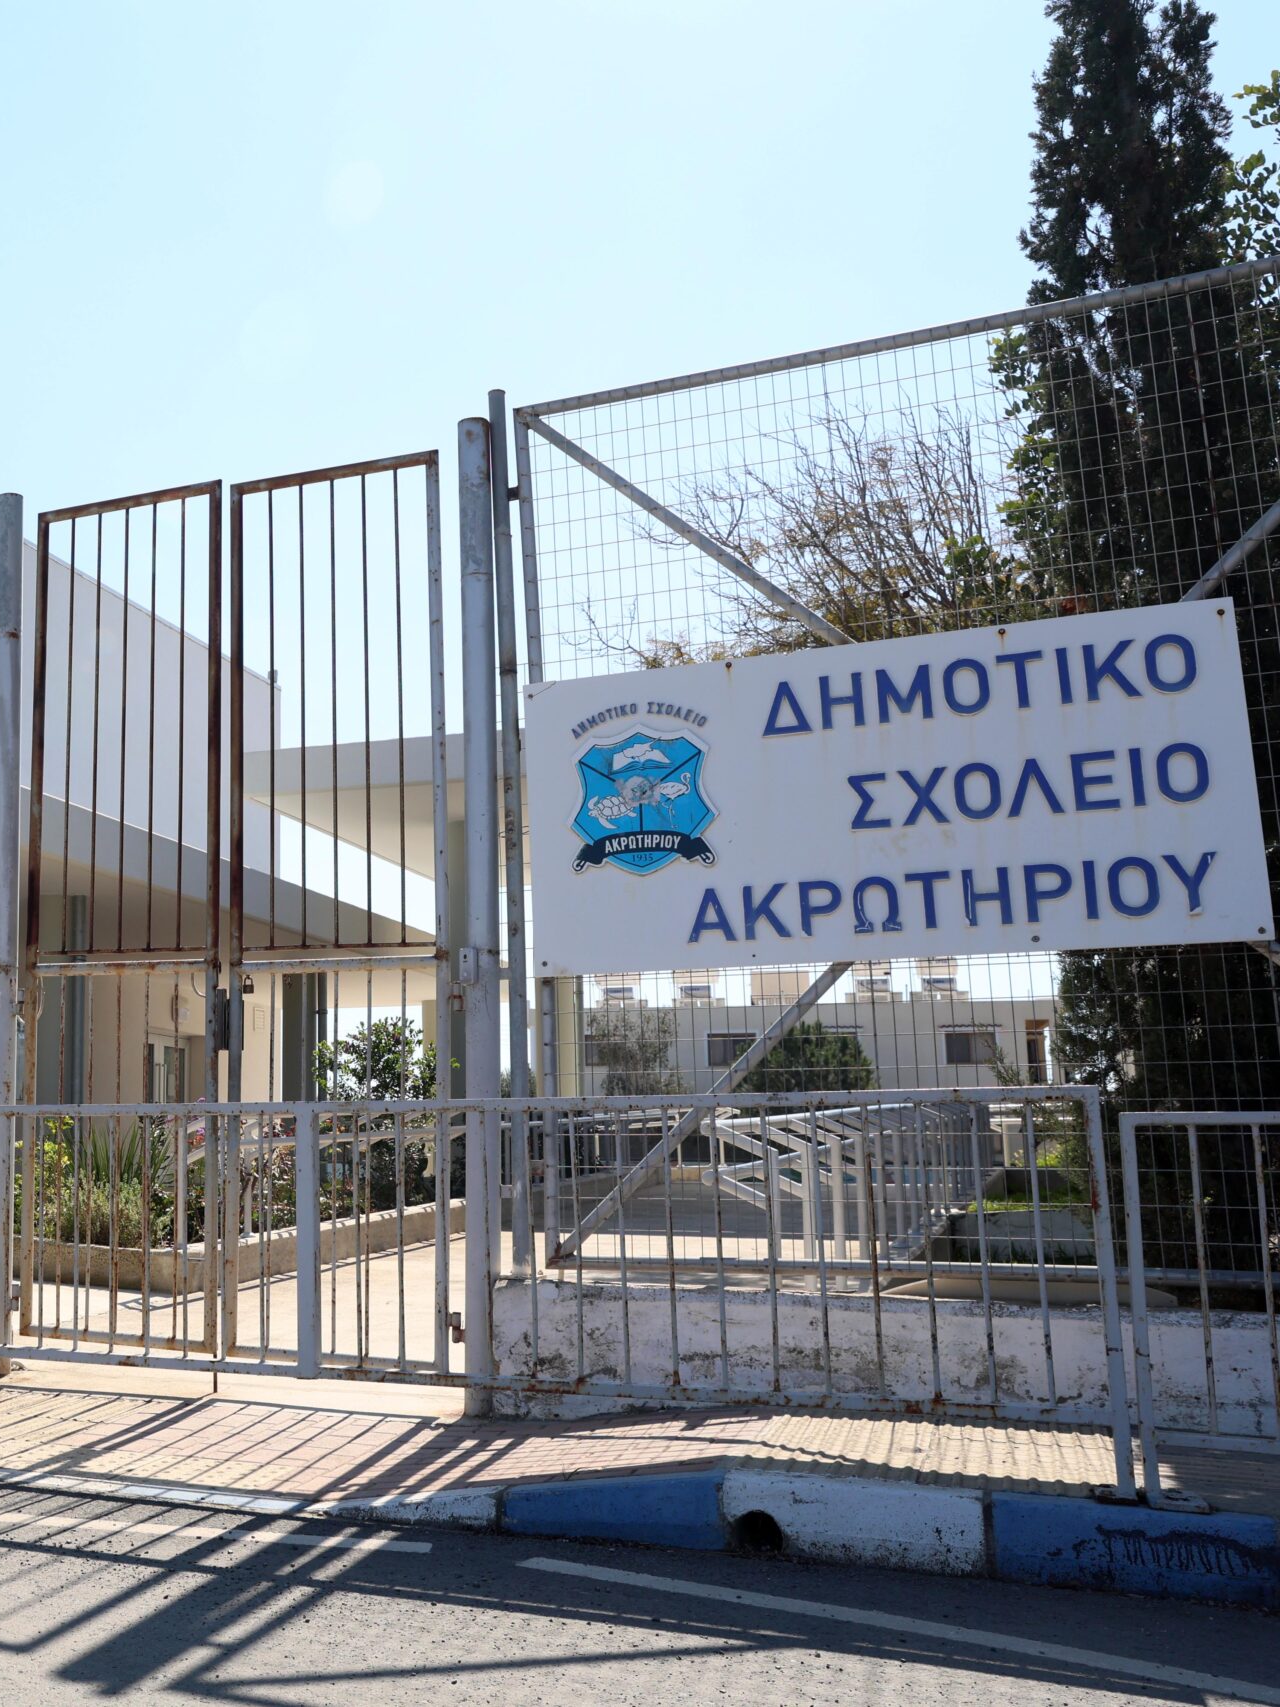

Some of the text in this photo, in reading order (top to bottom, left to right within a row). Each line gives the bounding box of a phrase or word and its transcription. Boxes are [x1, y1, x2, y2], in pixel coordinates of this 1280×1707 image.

[763, 636, 1198, 737] ΔΗΜΟΤΙΚΟ
[571, 702, 708, 739] ΔΗΜΟΤΙΚΟ ΣΧΟΛΕΙΟ
[847, 743, 1211, 831] ΣΧΟΛΕΙΟ
[605, 835, 681, 853] ΑΚΡΩΤΗΡΙΟΥ
[631, 853, 654, 863] 1935
[688, 852, 1218, 944] ΑΚΡΩΤΗΡΙΟΥ
